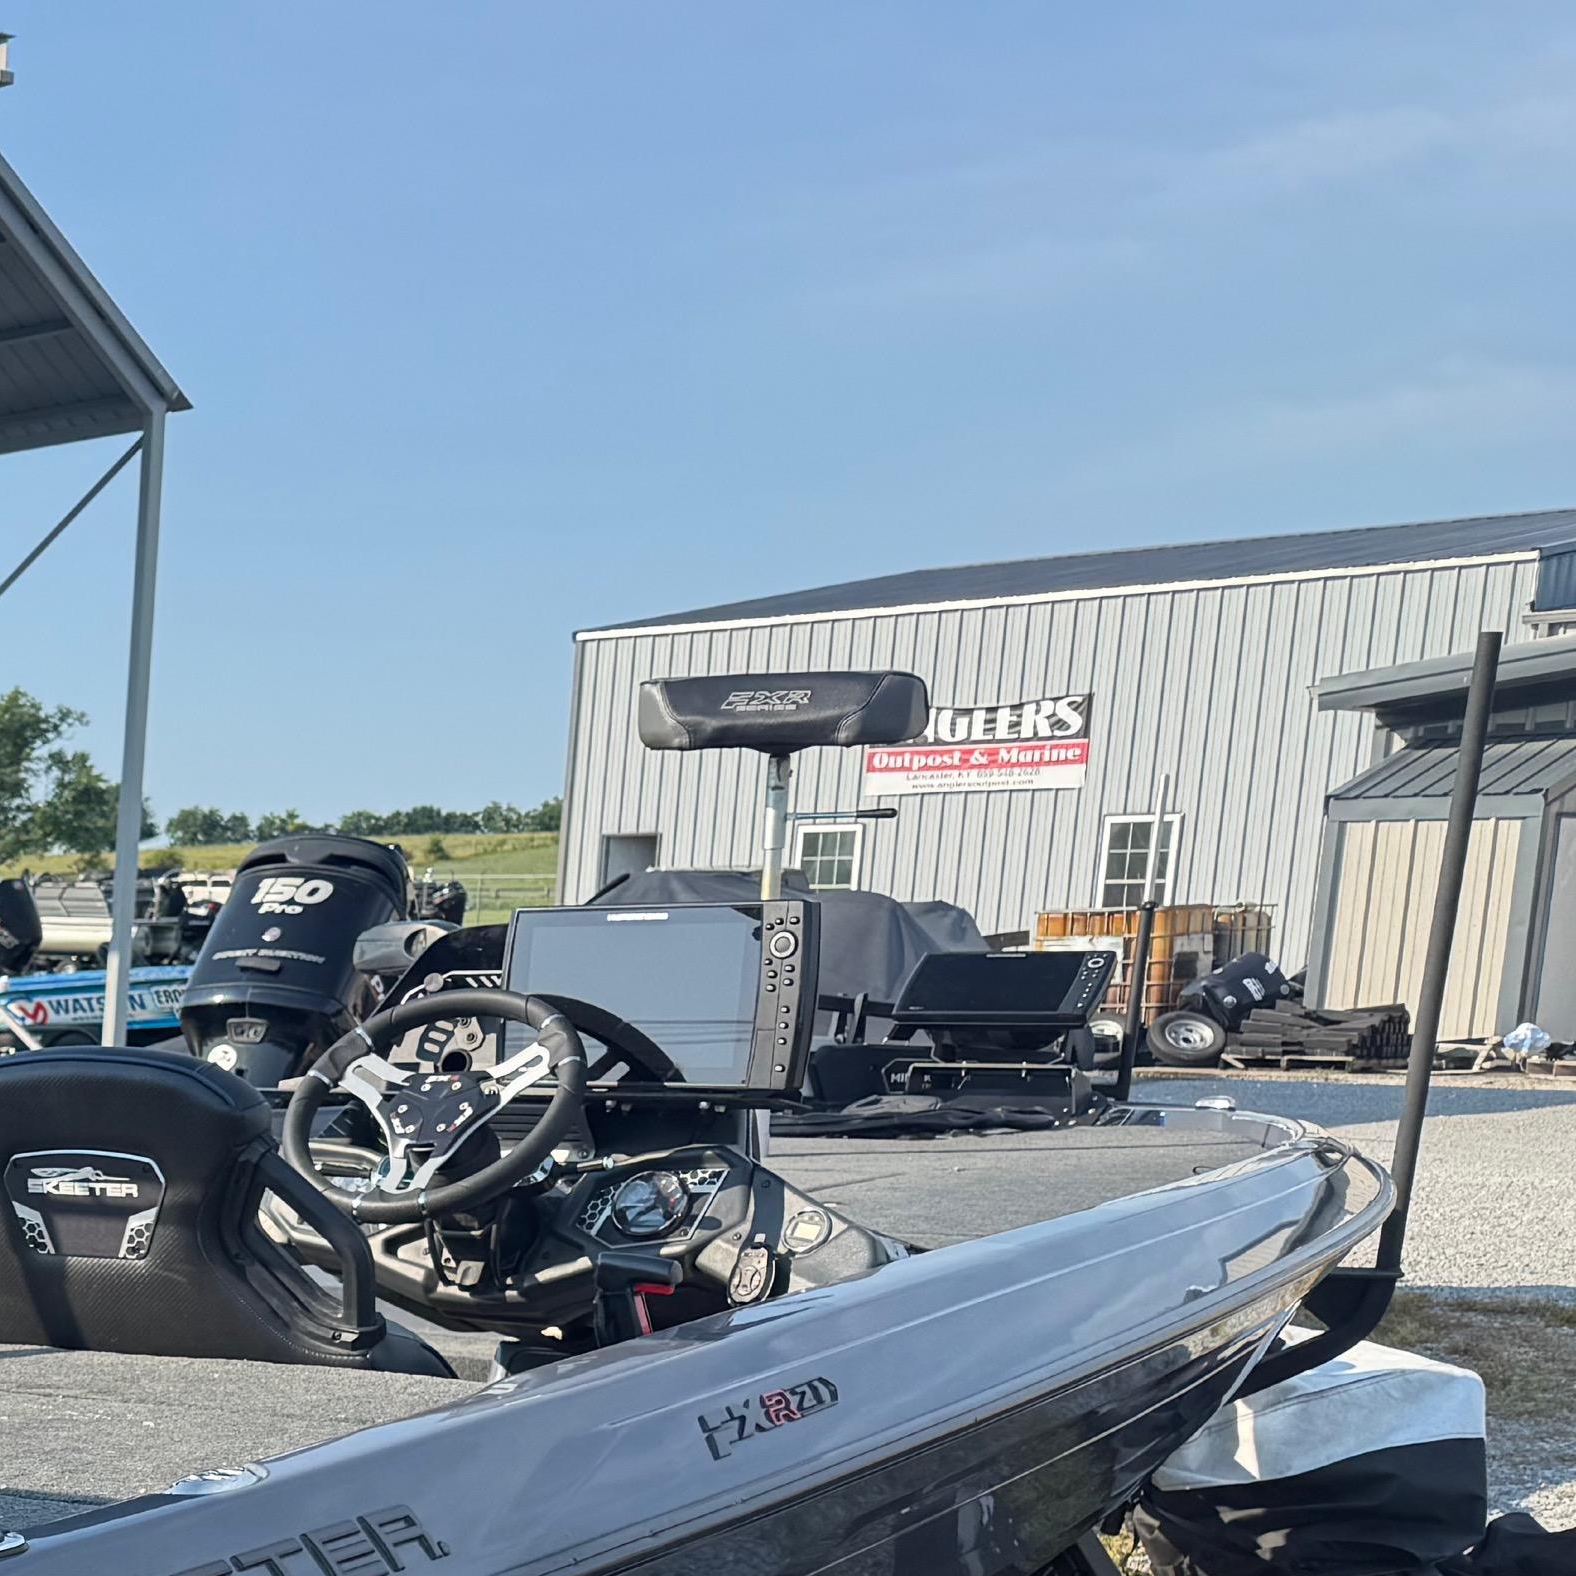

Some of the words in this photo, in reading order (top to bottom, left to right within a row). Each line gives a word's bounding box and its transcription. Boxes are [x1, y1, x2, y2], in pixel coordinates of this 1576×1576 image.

[872, 750, 962, 771] Outpost
[969, 750, 989, 766] &
[997, 744, 1083, 765] Marine
[250, 877, 334, 905] 150
[257, 902, 304, 914] Pro
[27, 1178, 139, 1198] SKEETER
